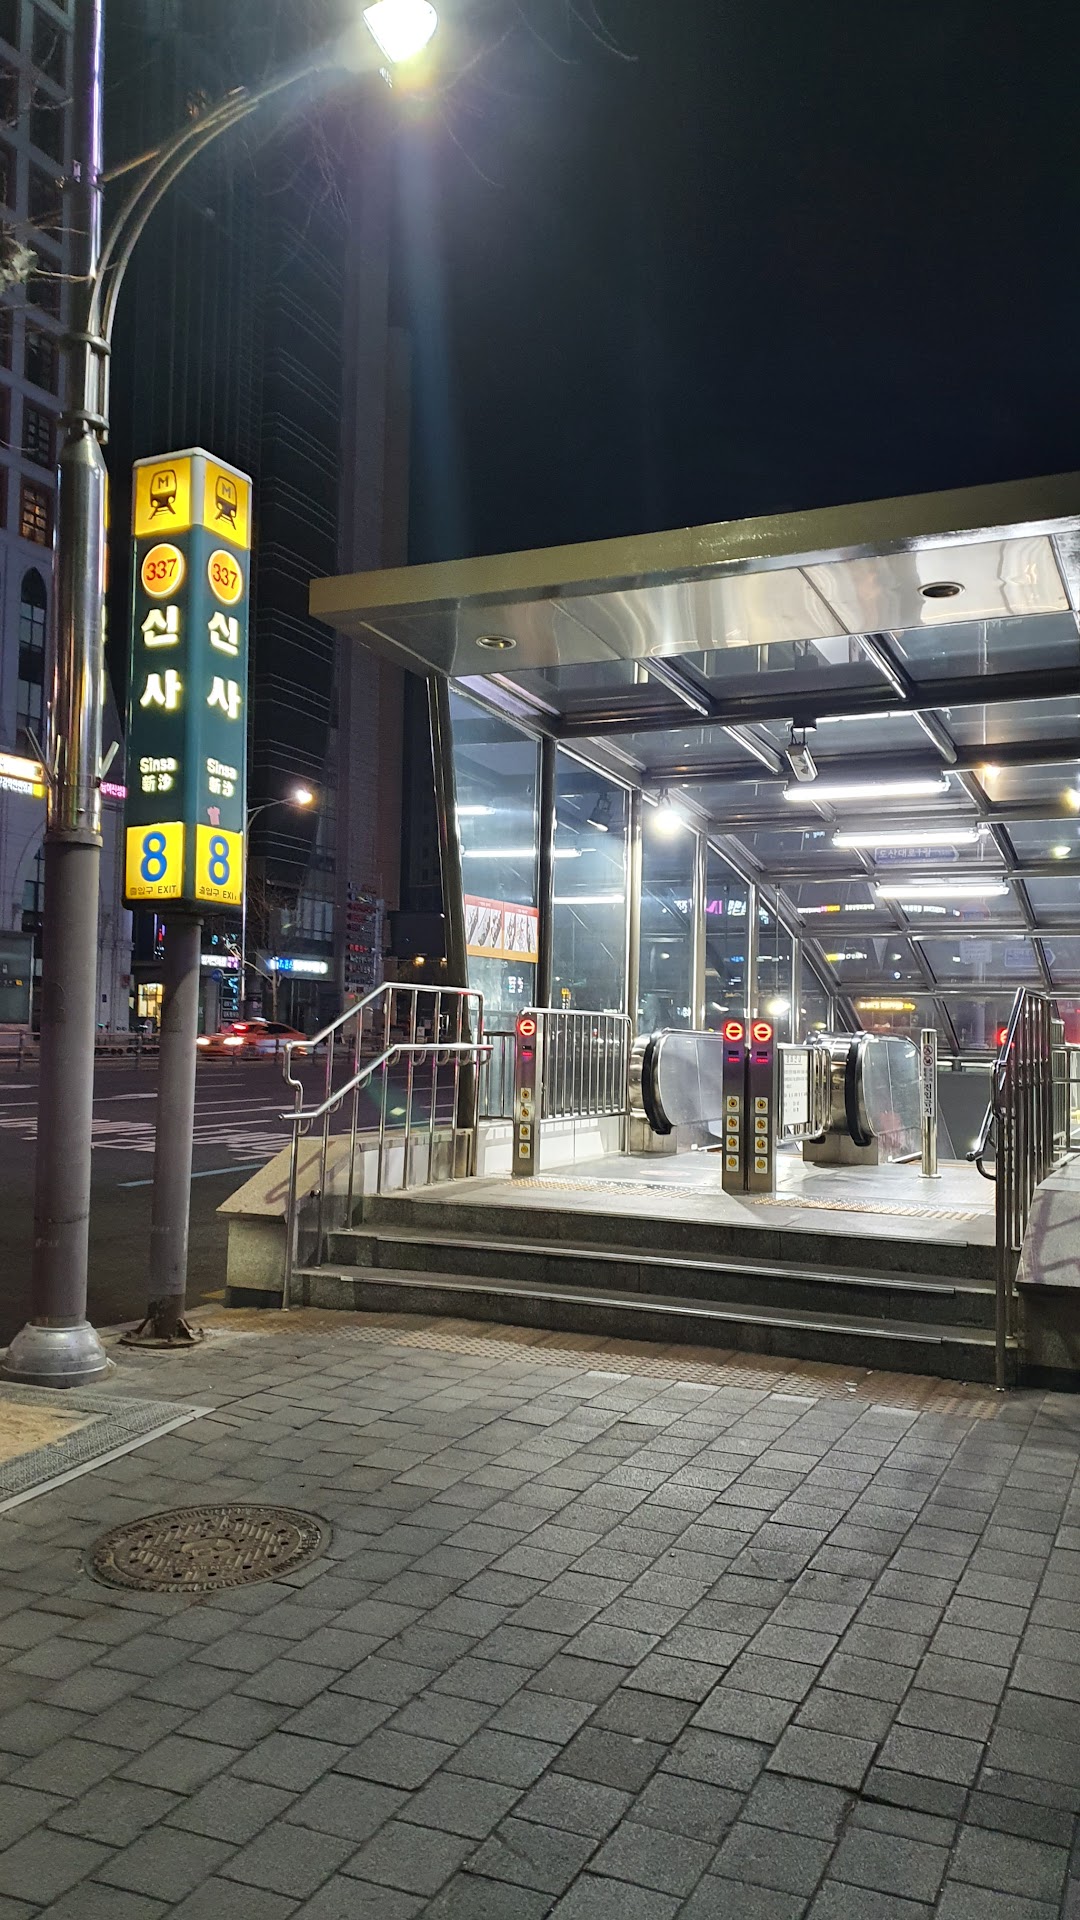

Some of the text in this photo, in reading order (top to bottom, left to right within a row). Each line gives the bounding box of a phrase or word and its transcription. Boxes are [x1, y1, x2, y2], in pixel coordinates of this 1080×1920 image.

[146, 558, 177, 581] 337
[213, 563, 238, 589] 337
[140, 605, 182, 710] 신사
[206, 611, 242, 719] 신사
[140, 757, 178, 774] Sinsa
[206, 757, 239, 780] Sinsa
[140, 831, 168, 883] 8
[208, 835, 230, 886] 8
[157, 885, 177, 894] EXIT
